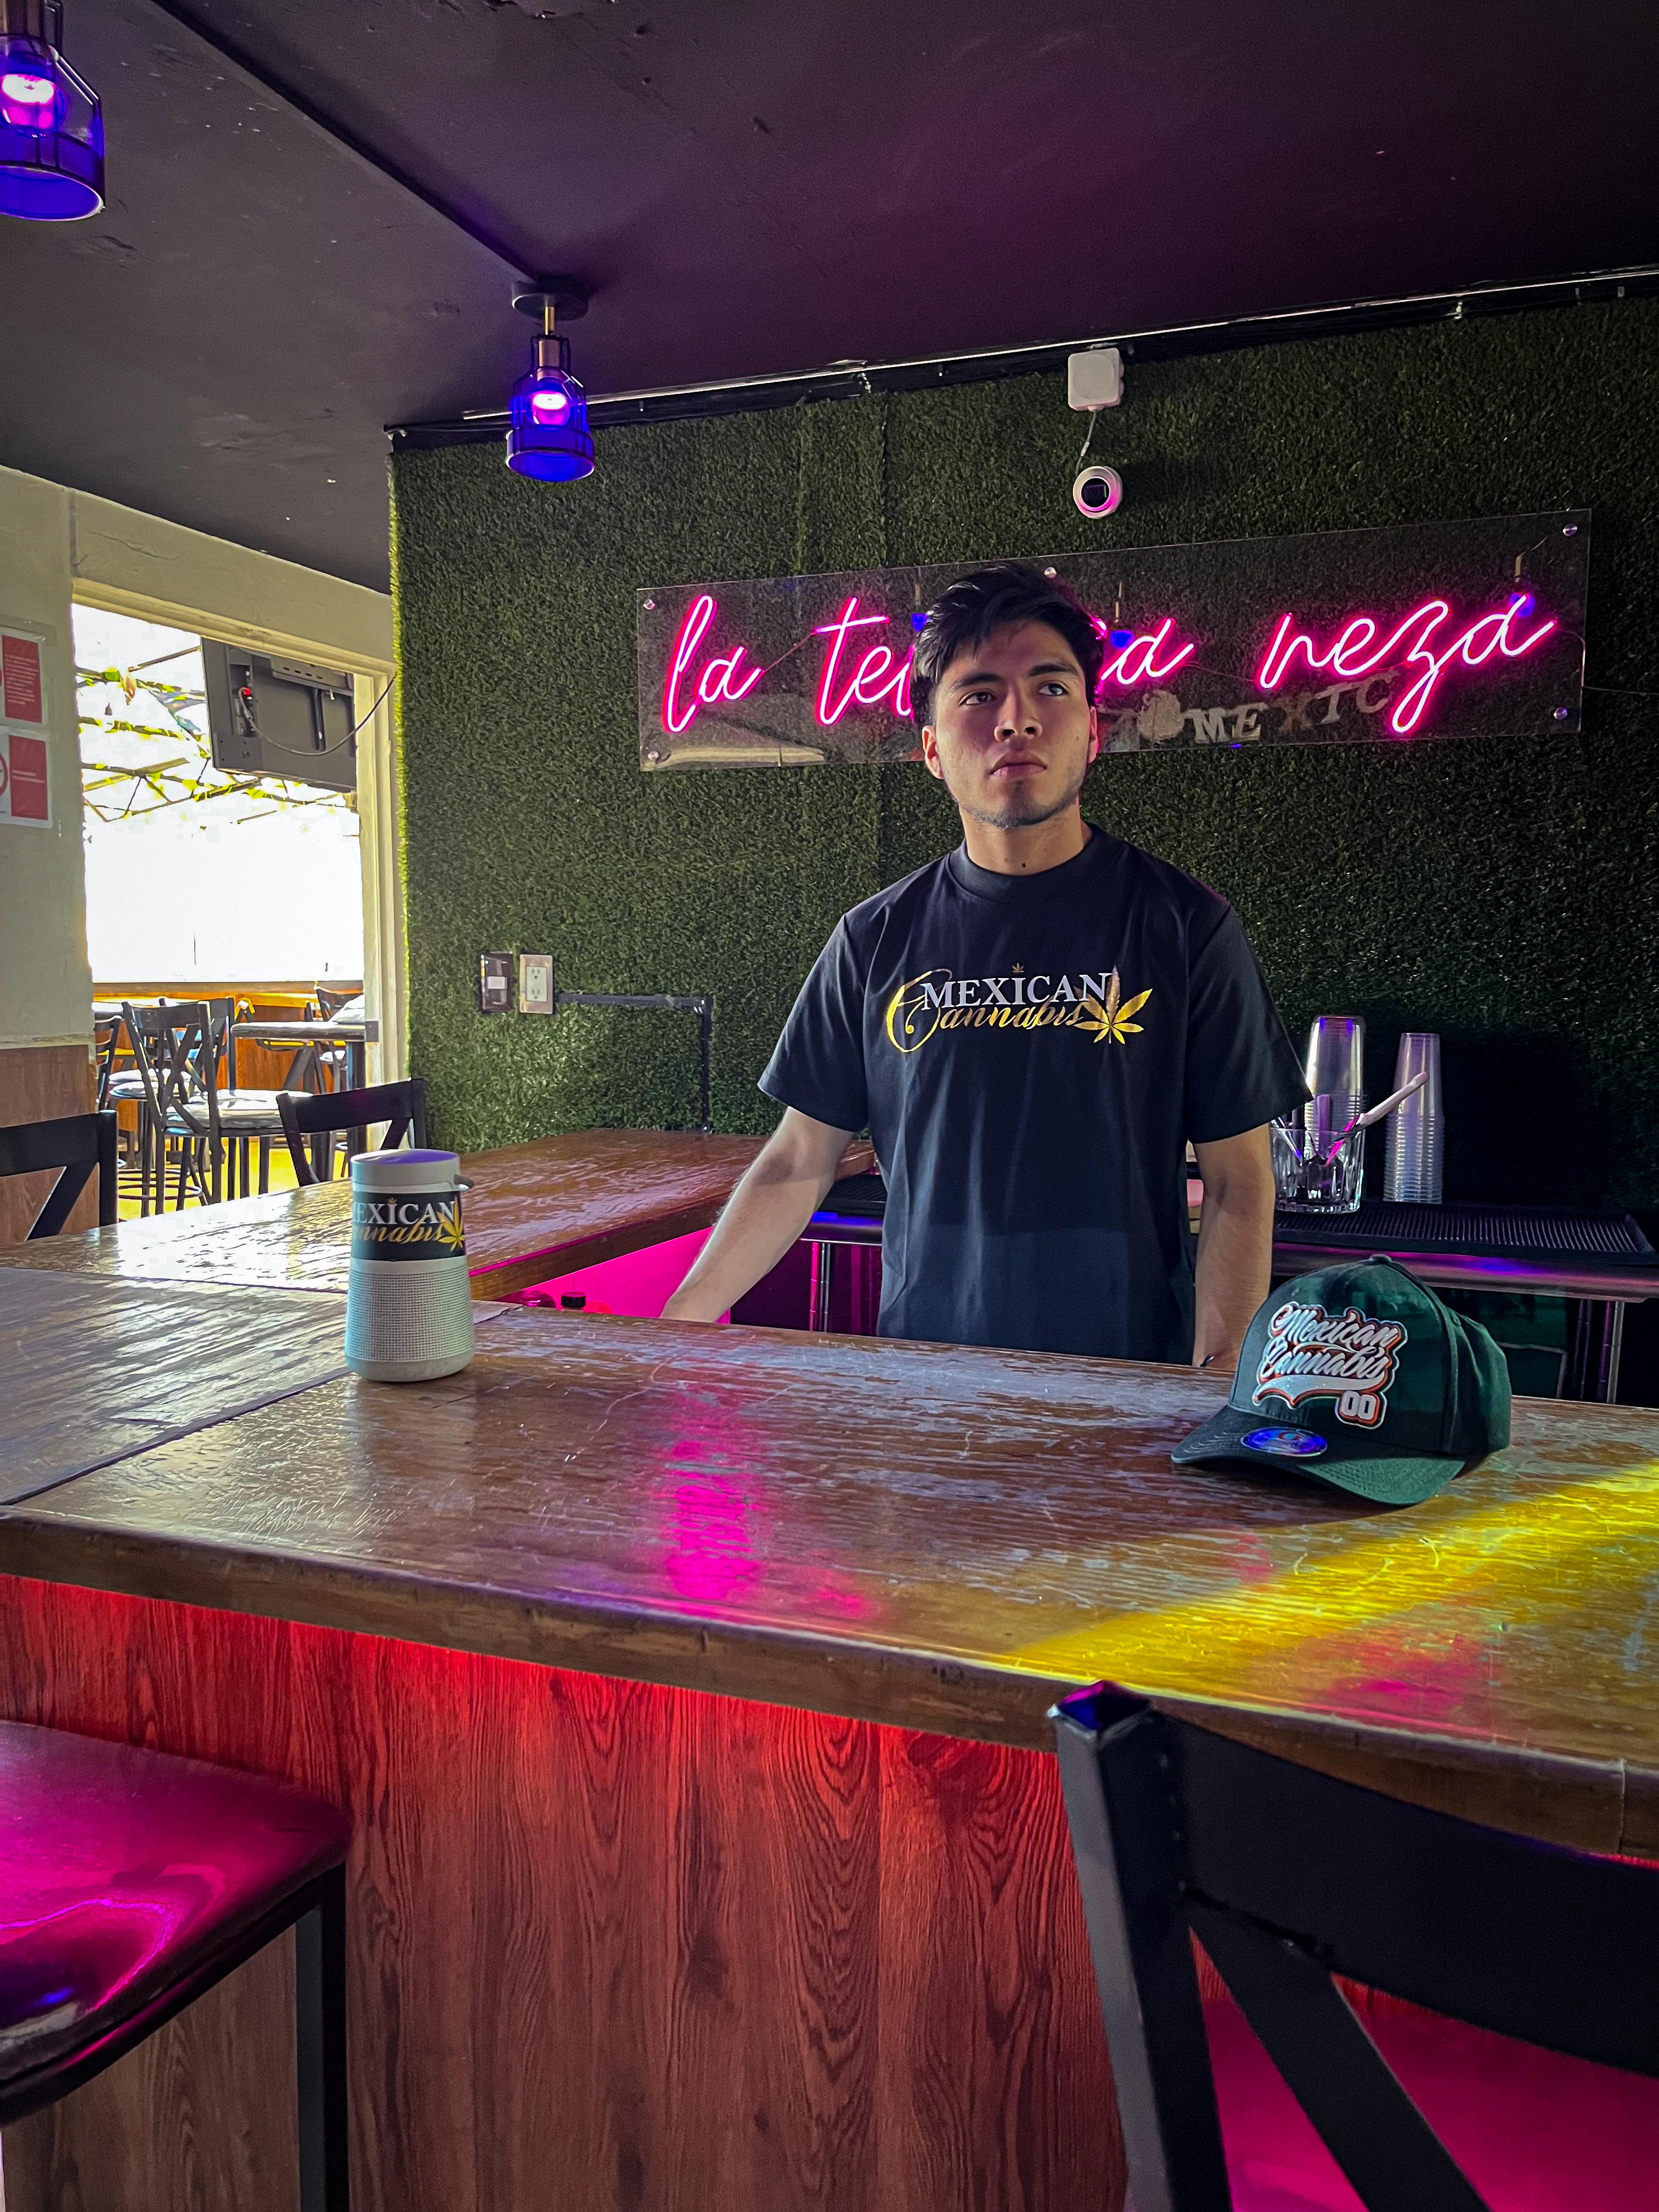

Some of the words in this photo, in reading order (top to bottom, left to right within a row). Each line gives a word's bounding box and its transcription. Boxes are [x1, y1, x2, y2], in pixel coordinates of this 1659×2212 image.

[664, 594, 763, 733] la
[1260, 594, 1557, 734] neza
[885, 968, 1086, 1053] Cannabis
[920, 972, 1114, 1011] MEXICAN
[353, 1201, 455, 1224] EXICAN
[358, 1214, 444, 1244] nnabis
[1270, 1303, 1399, 1350] Mexican
[1260, 1334, 1390, 1379] Cannabis
[1341, 1389, 1377, 1420] 00
